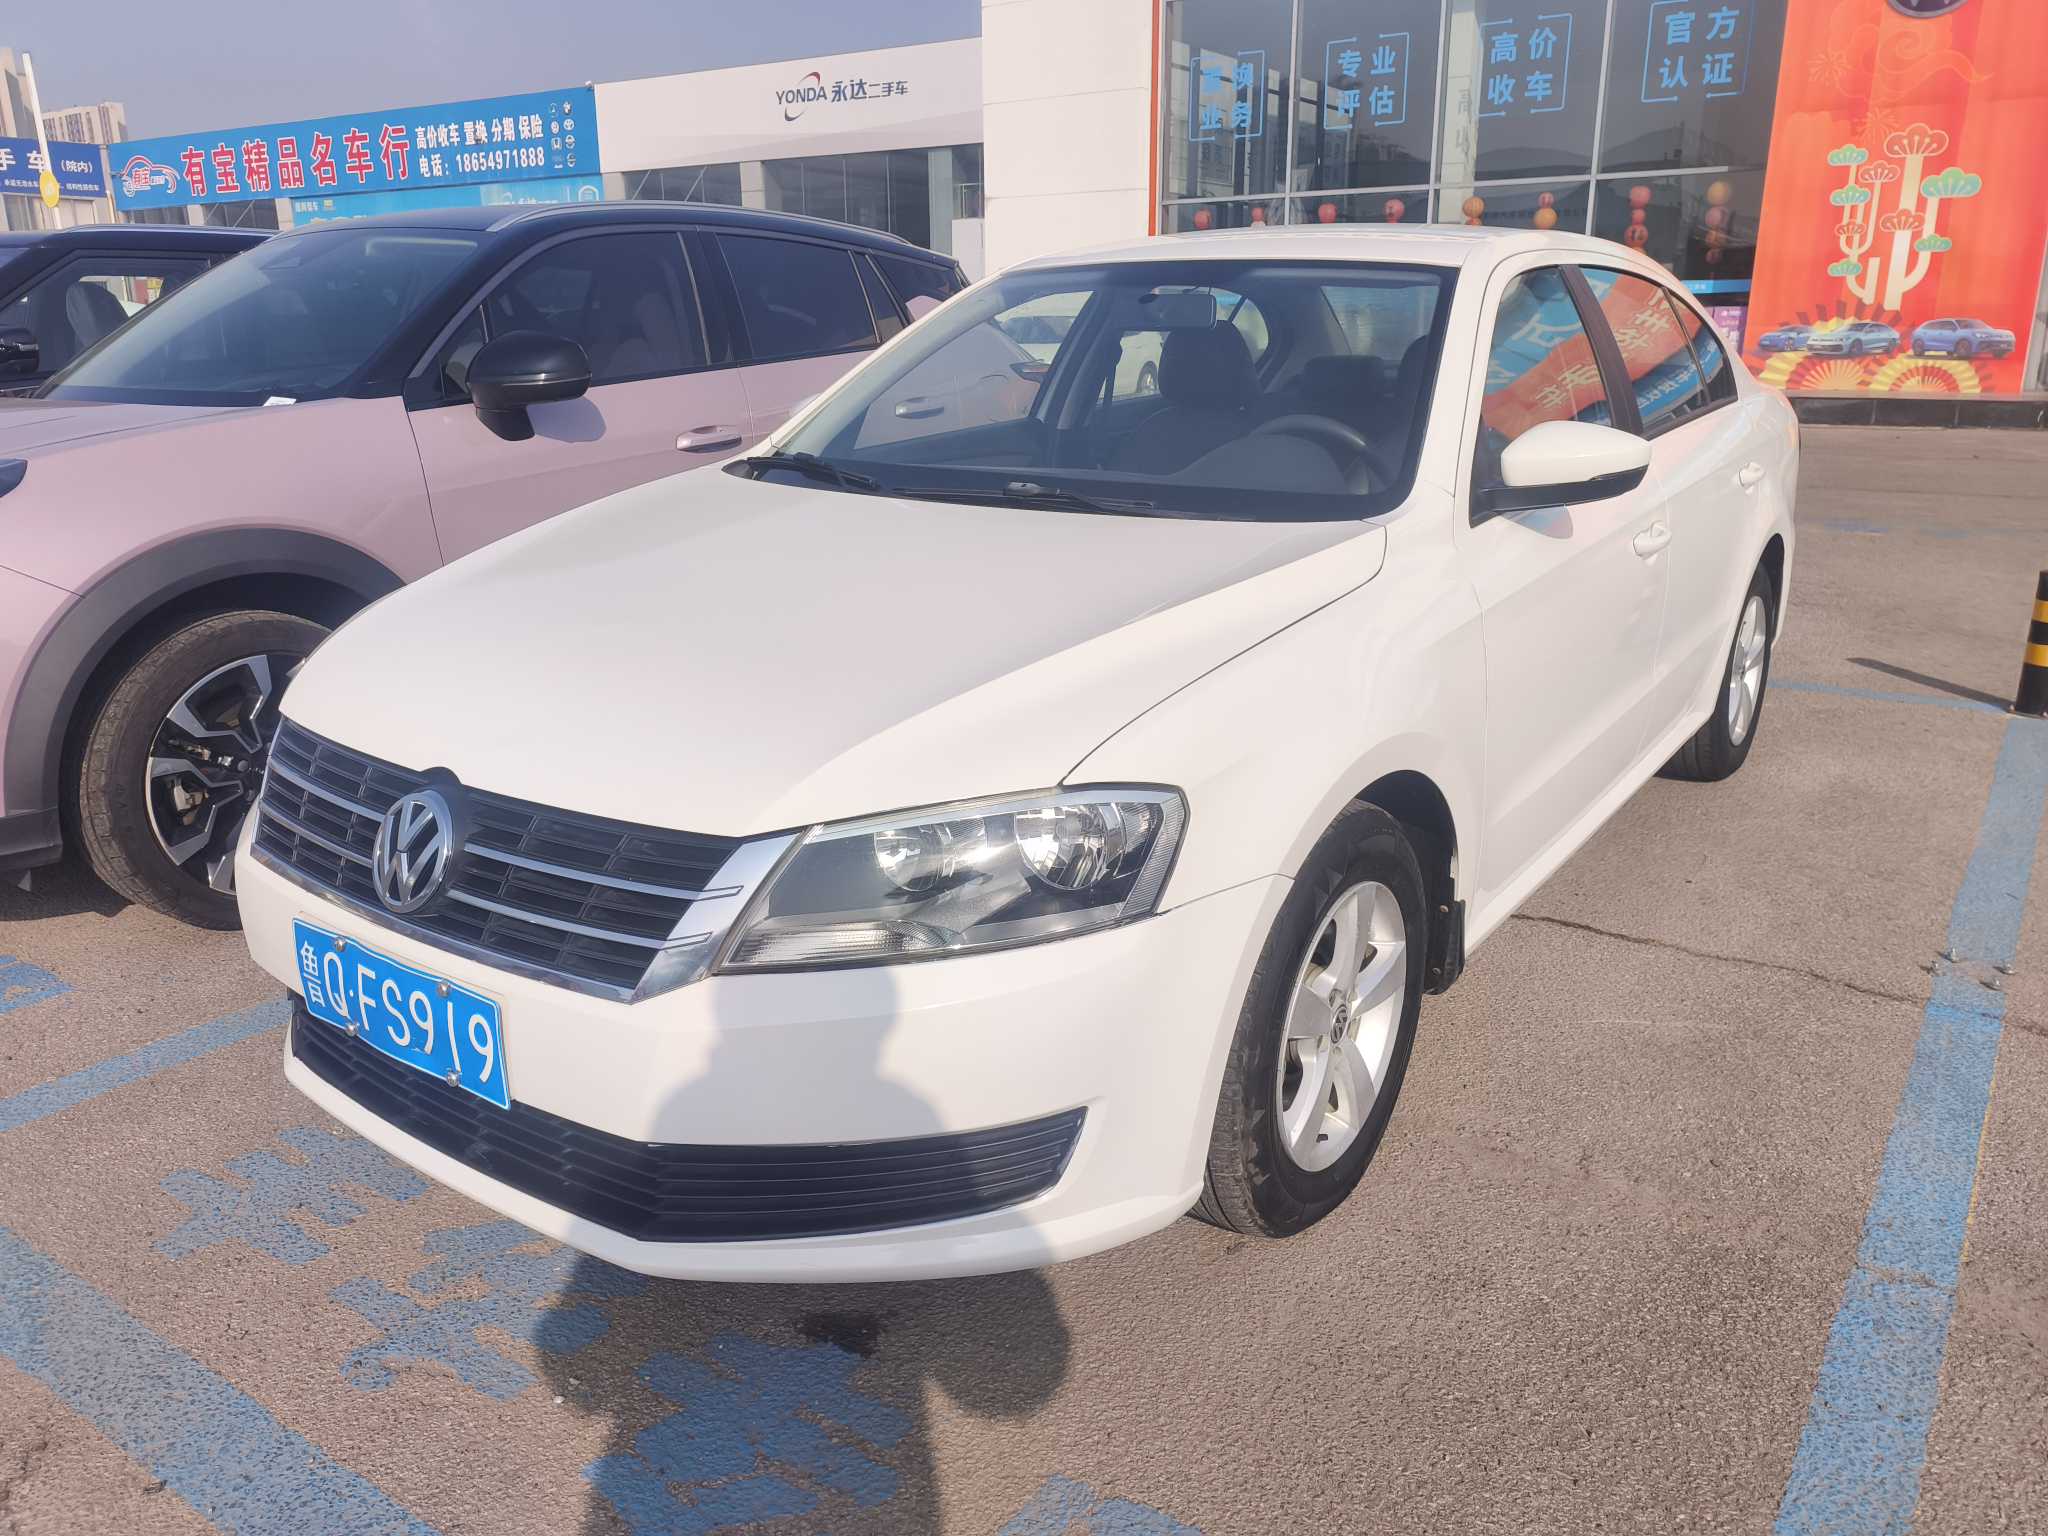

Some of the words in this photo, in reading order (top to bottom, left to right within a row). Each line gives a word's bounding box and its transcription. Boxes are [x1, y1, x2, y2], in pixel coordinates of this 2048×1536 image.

[1664, 6, 1740, 45] 官方
[1338, 46, 1396, 78] 专业
[1490, 27, 1557, 65] 高价
[1487, 70, 1554, 105] 收车
[1658, 52, 1736, 89] 认证
[775, 86, 827, 105] YONDA
[831, 78, 909, 103] 永达二手车
[1337, 84, 1395, 118] 评估
[415, 123, 461, 149] 高价收车
[463, 120, 488, 146] 置换
[491, 116, 516, 143] 分期
[518, 113, 545, 141] 保险
[1200, 100, 1253, 130] 业务
[180, 123, 411, 198] 有宝精品名车行
[455, 147, 546, 174] 18654971888
